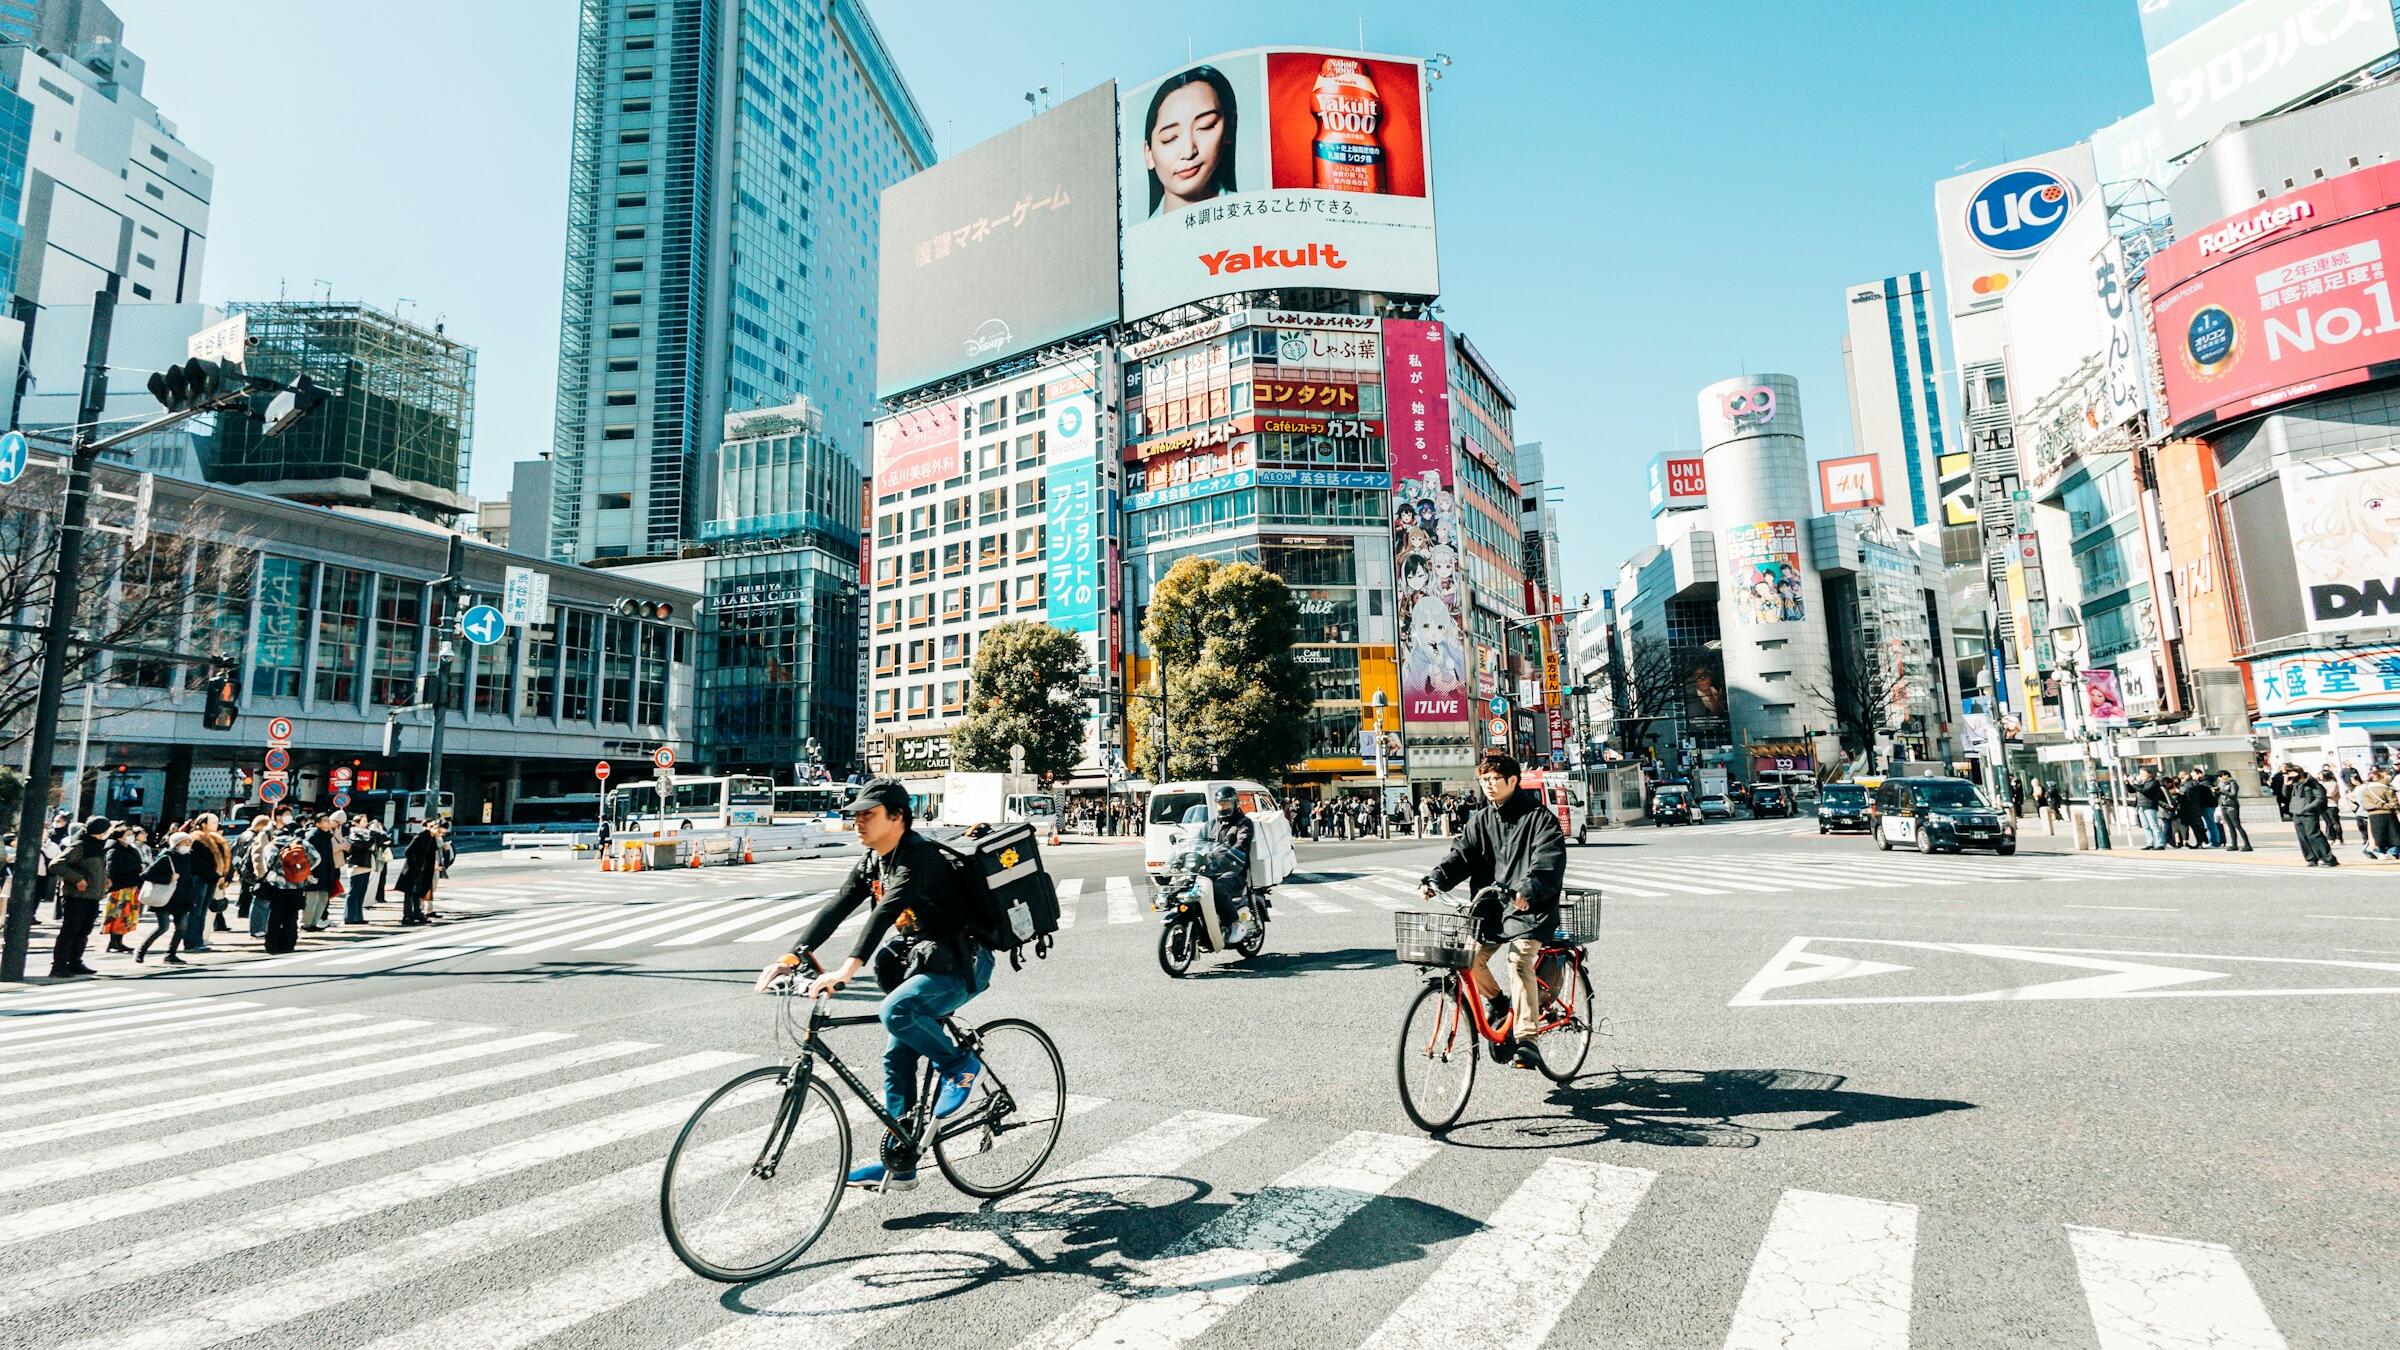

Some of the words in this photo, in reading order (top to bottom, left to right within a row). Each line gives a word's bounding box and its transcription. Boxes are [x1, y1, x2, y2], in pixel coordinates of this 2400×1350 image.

[1315, 93, 1377, 115] Yakult
[1317, 110, 1377, 134] 1000
[2198, 199, 2312, 256] Rakuten
[1198, 243, 1348, 276] Yakult
[2280, 252, 2350, 284] 2年連続
[2258, 265, 2371, 312] 顧客満足度
[1267, 312, 1374, 329] しゃぶしゃぶバイキング
[2262, 280, 2400, 362] No.1
[2194, 328, 2226, 347] オリコン
[1312, 338, 1376, 360] しゃぶ葉
[1126, 372, 1142, 387] 9F
[2287, 383, 2317, 397] Vision
[1253, 383, 1355, 407] コンタクト
[1717, 385, 1776, 424] 109
[1408, 353, 1428, 460] 私が、始まる。
[1194, 422, 1237, 449] ガスト
[1327, 420, 1374, 438] ガスト
[1127, 471, 1145, 488] 7F
[1262, 471, 1293, 483] AEON
[1299, 472, 1388, 485] 英会話イーオン
[1671, 463, 1701, 477] UNI
[1157, 478, 1231, 504] 英会話イーオン
[1672, 477, 1706, 495] QLO
[1051, 483, 1073, 607] アイシティ
[1074, 479, 1092, 604] コンタクトの
[515, 573, 528, 622] 渋谷駅前
[712, 593, 761, 607] MARK
[767, 589, 807, 601] CITY
[736, 583, 781, 593] SHIBUYA
[1414, 700, 1458, 715] 17LIVE
[1518, 714, 1534, 733] LUSH
[1775, 758, 1794, 771] 109
